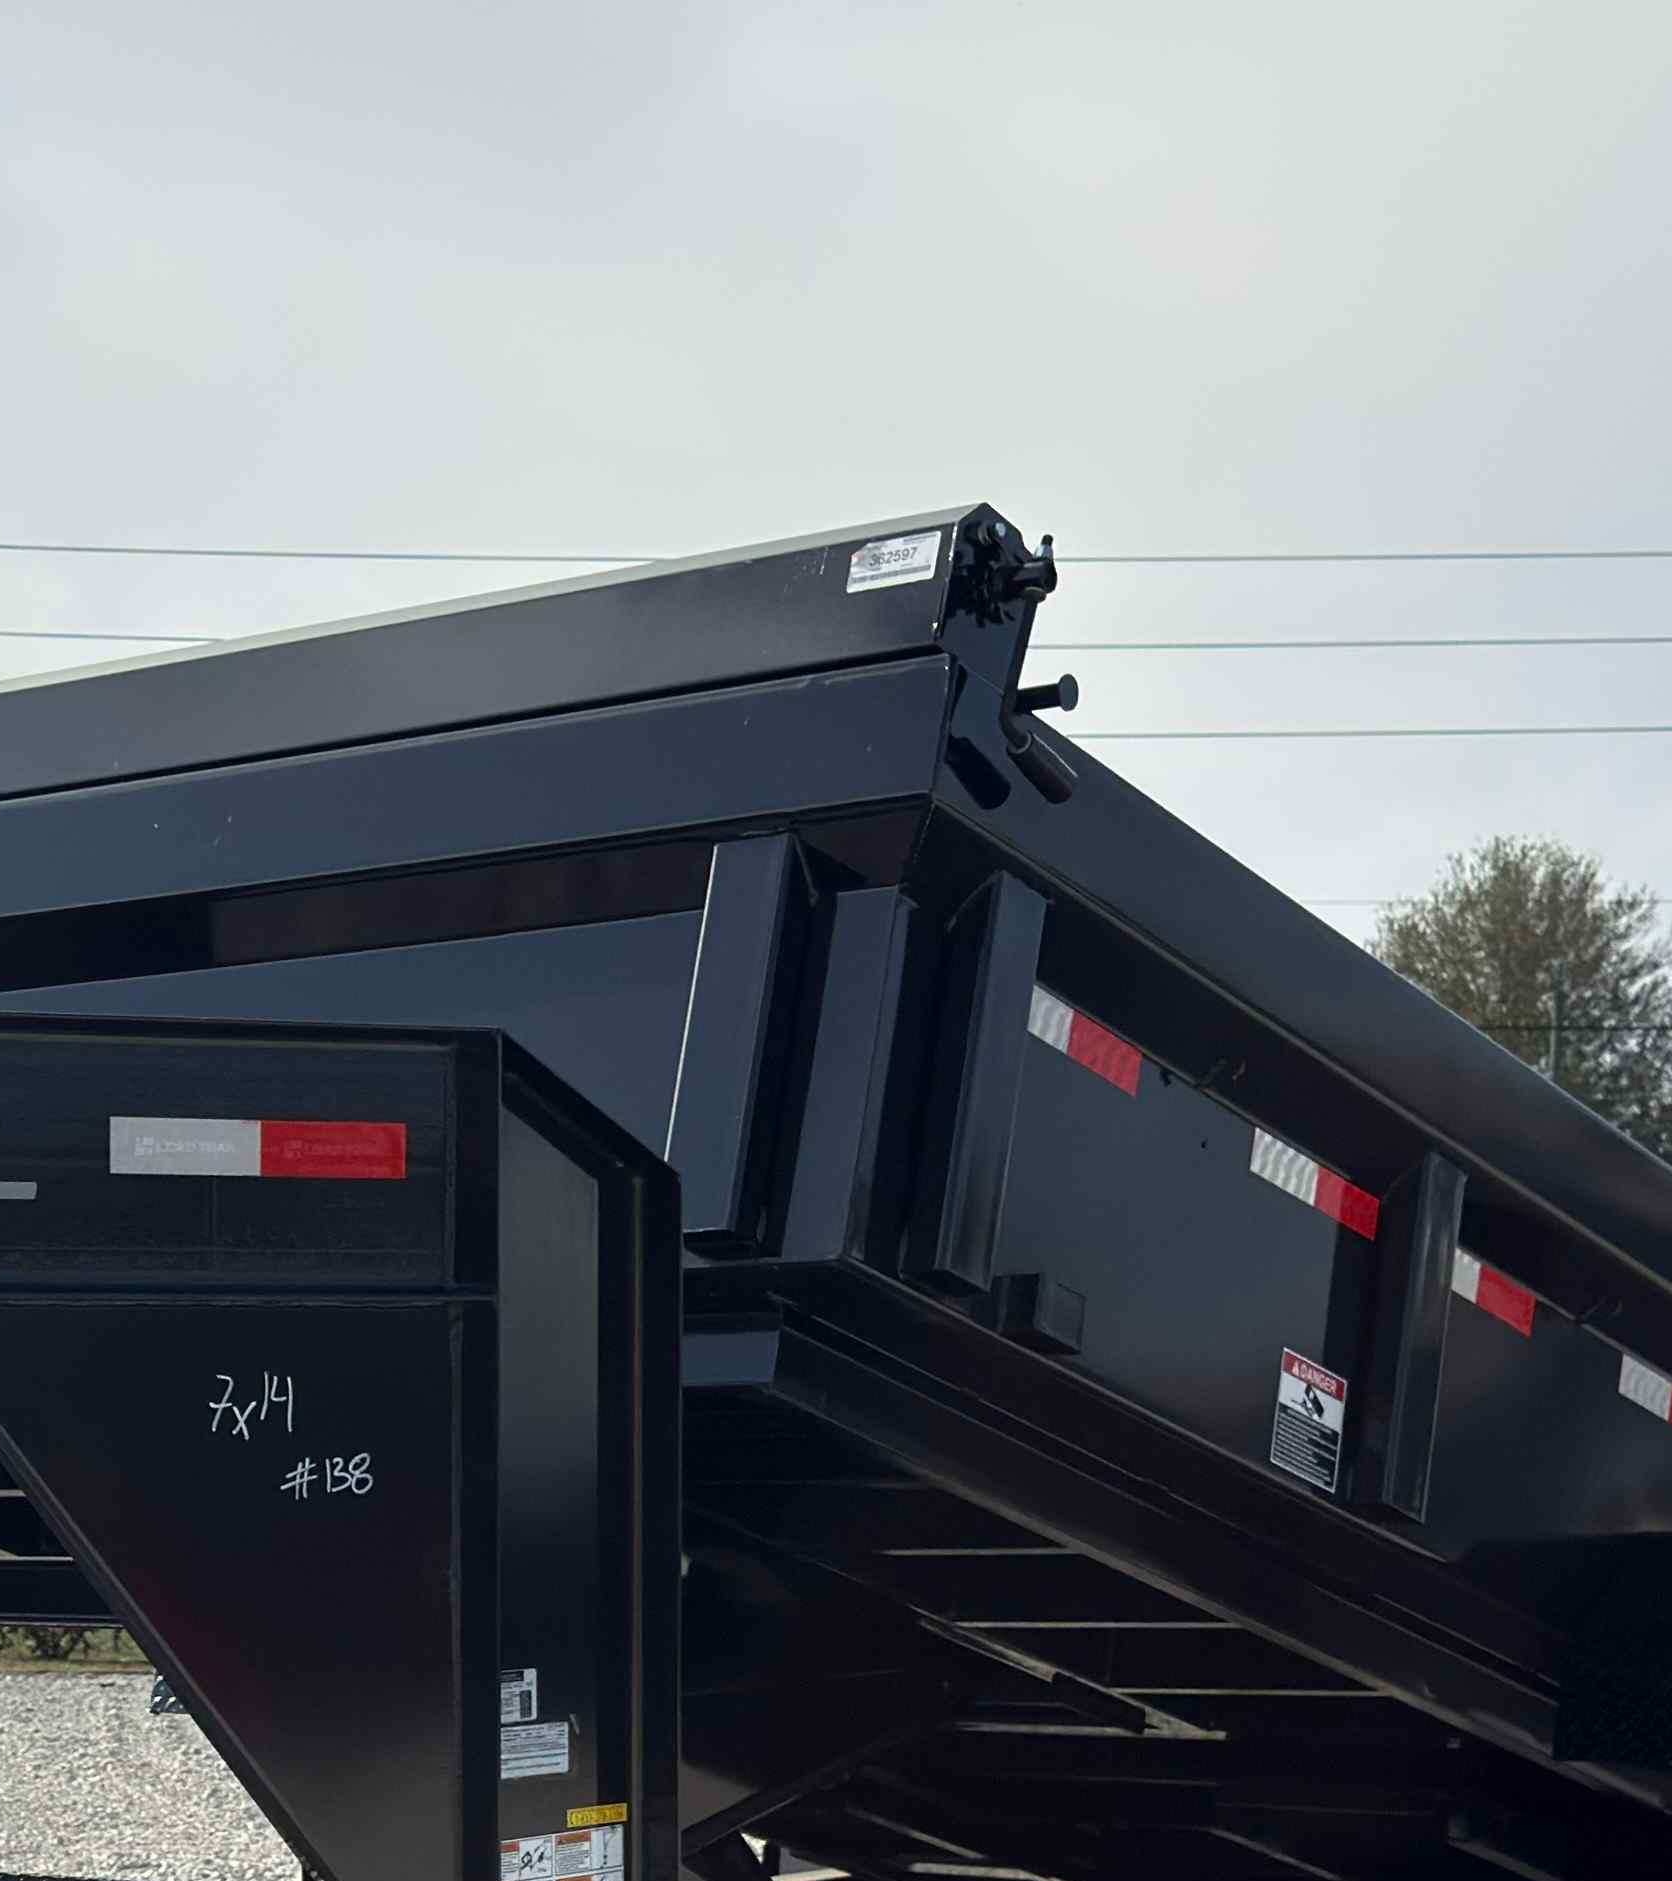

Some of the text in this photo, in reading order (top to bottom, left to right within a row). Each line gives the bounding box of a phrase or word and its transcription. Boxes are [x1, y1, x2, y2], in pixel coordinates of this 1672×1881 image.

[868, 546, 918, 567] 362597
[208, 1370, 294, 1441] 7x14
[279, 1452, 374, 1501] #138
